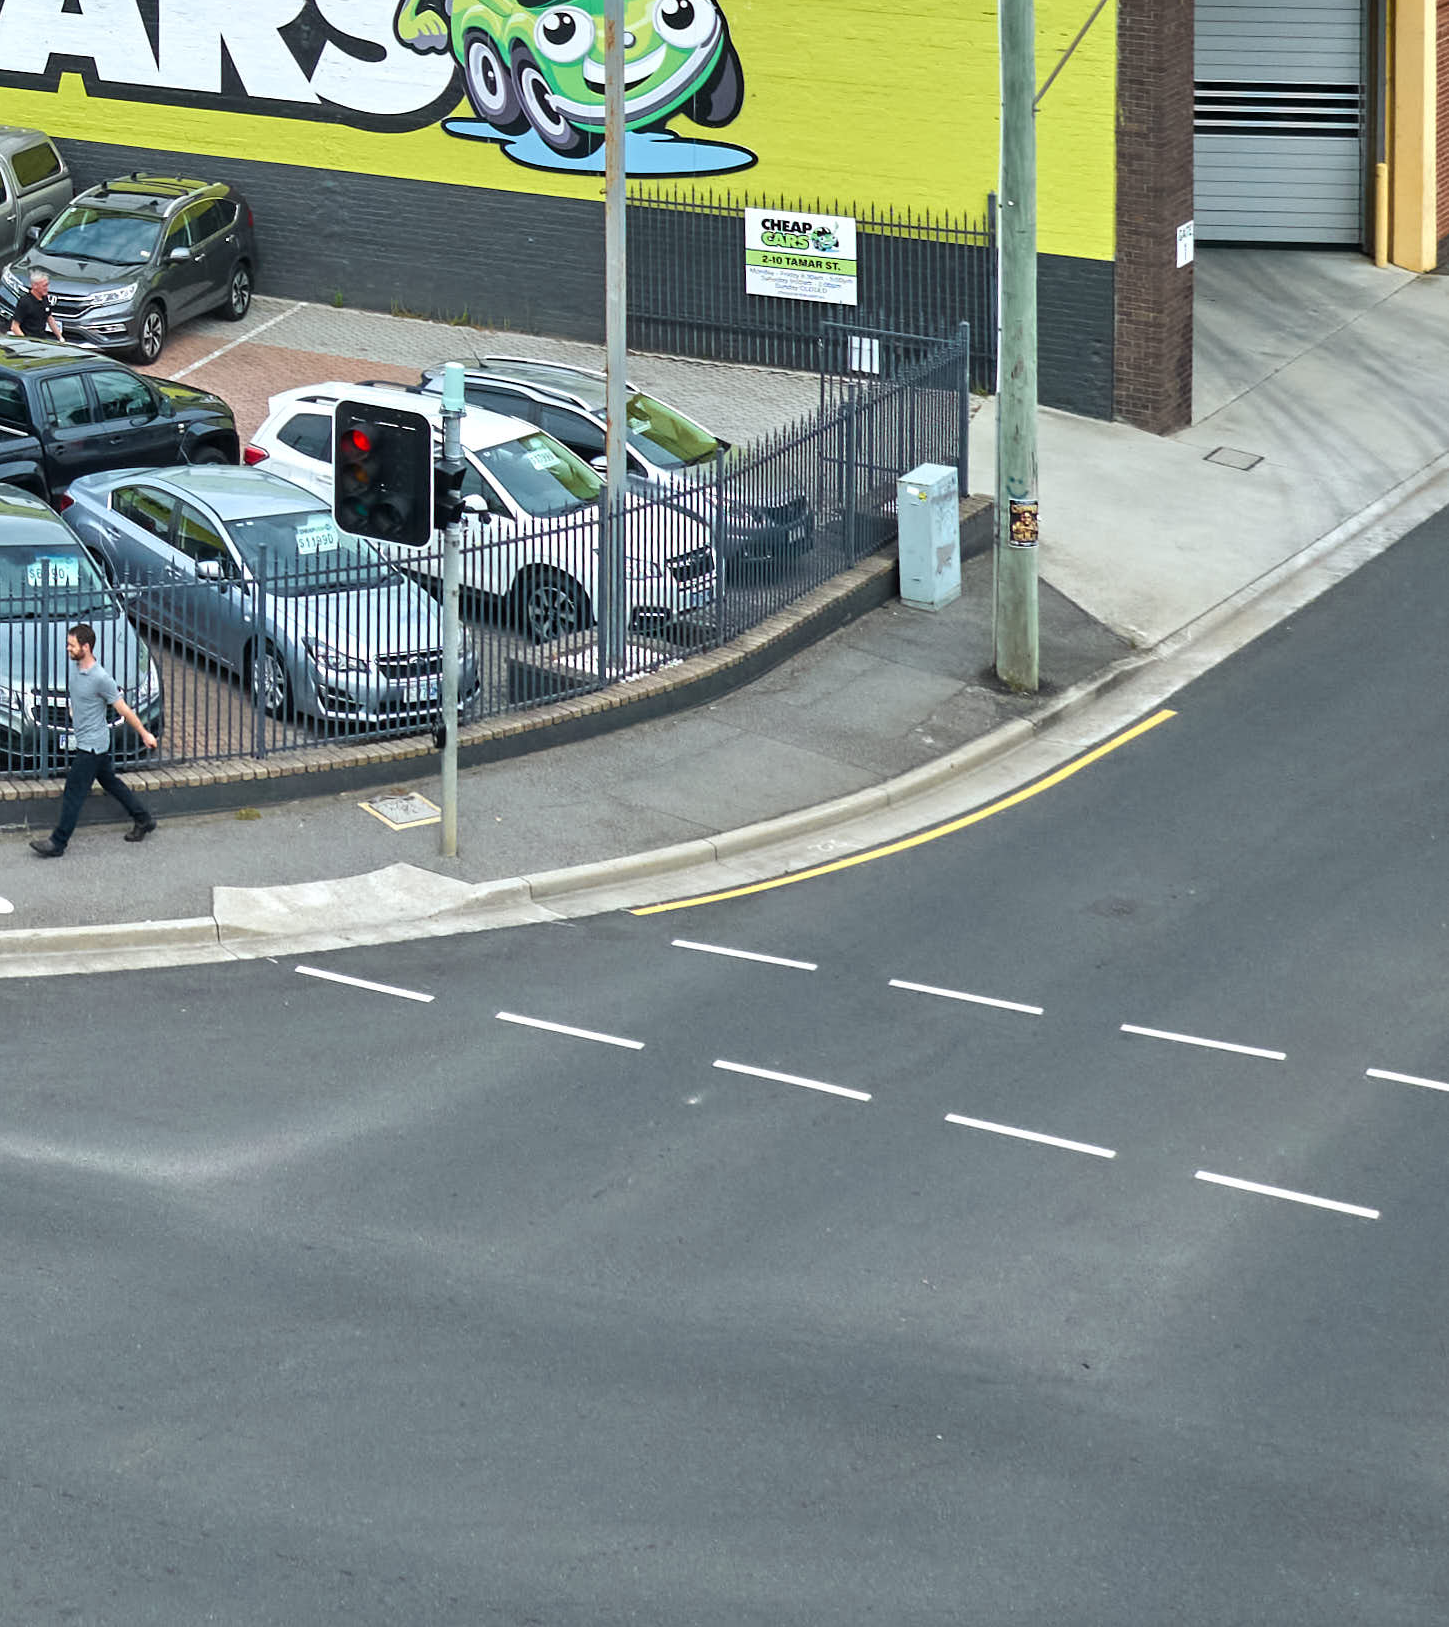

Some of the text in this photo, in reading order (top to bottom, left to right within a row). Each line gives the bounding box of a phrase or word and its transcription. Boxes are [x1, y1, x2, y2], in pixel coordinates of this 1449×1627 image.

[761, 218, 812, 234] CHEAP
[761, 231, 809, 250] CARS
[762, 255, 841, 271] 2-10 TAMAR ST.
